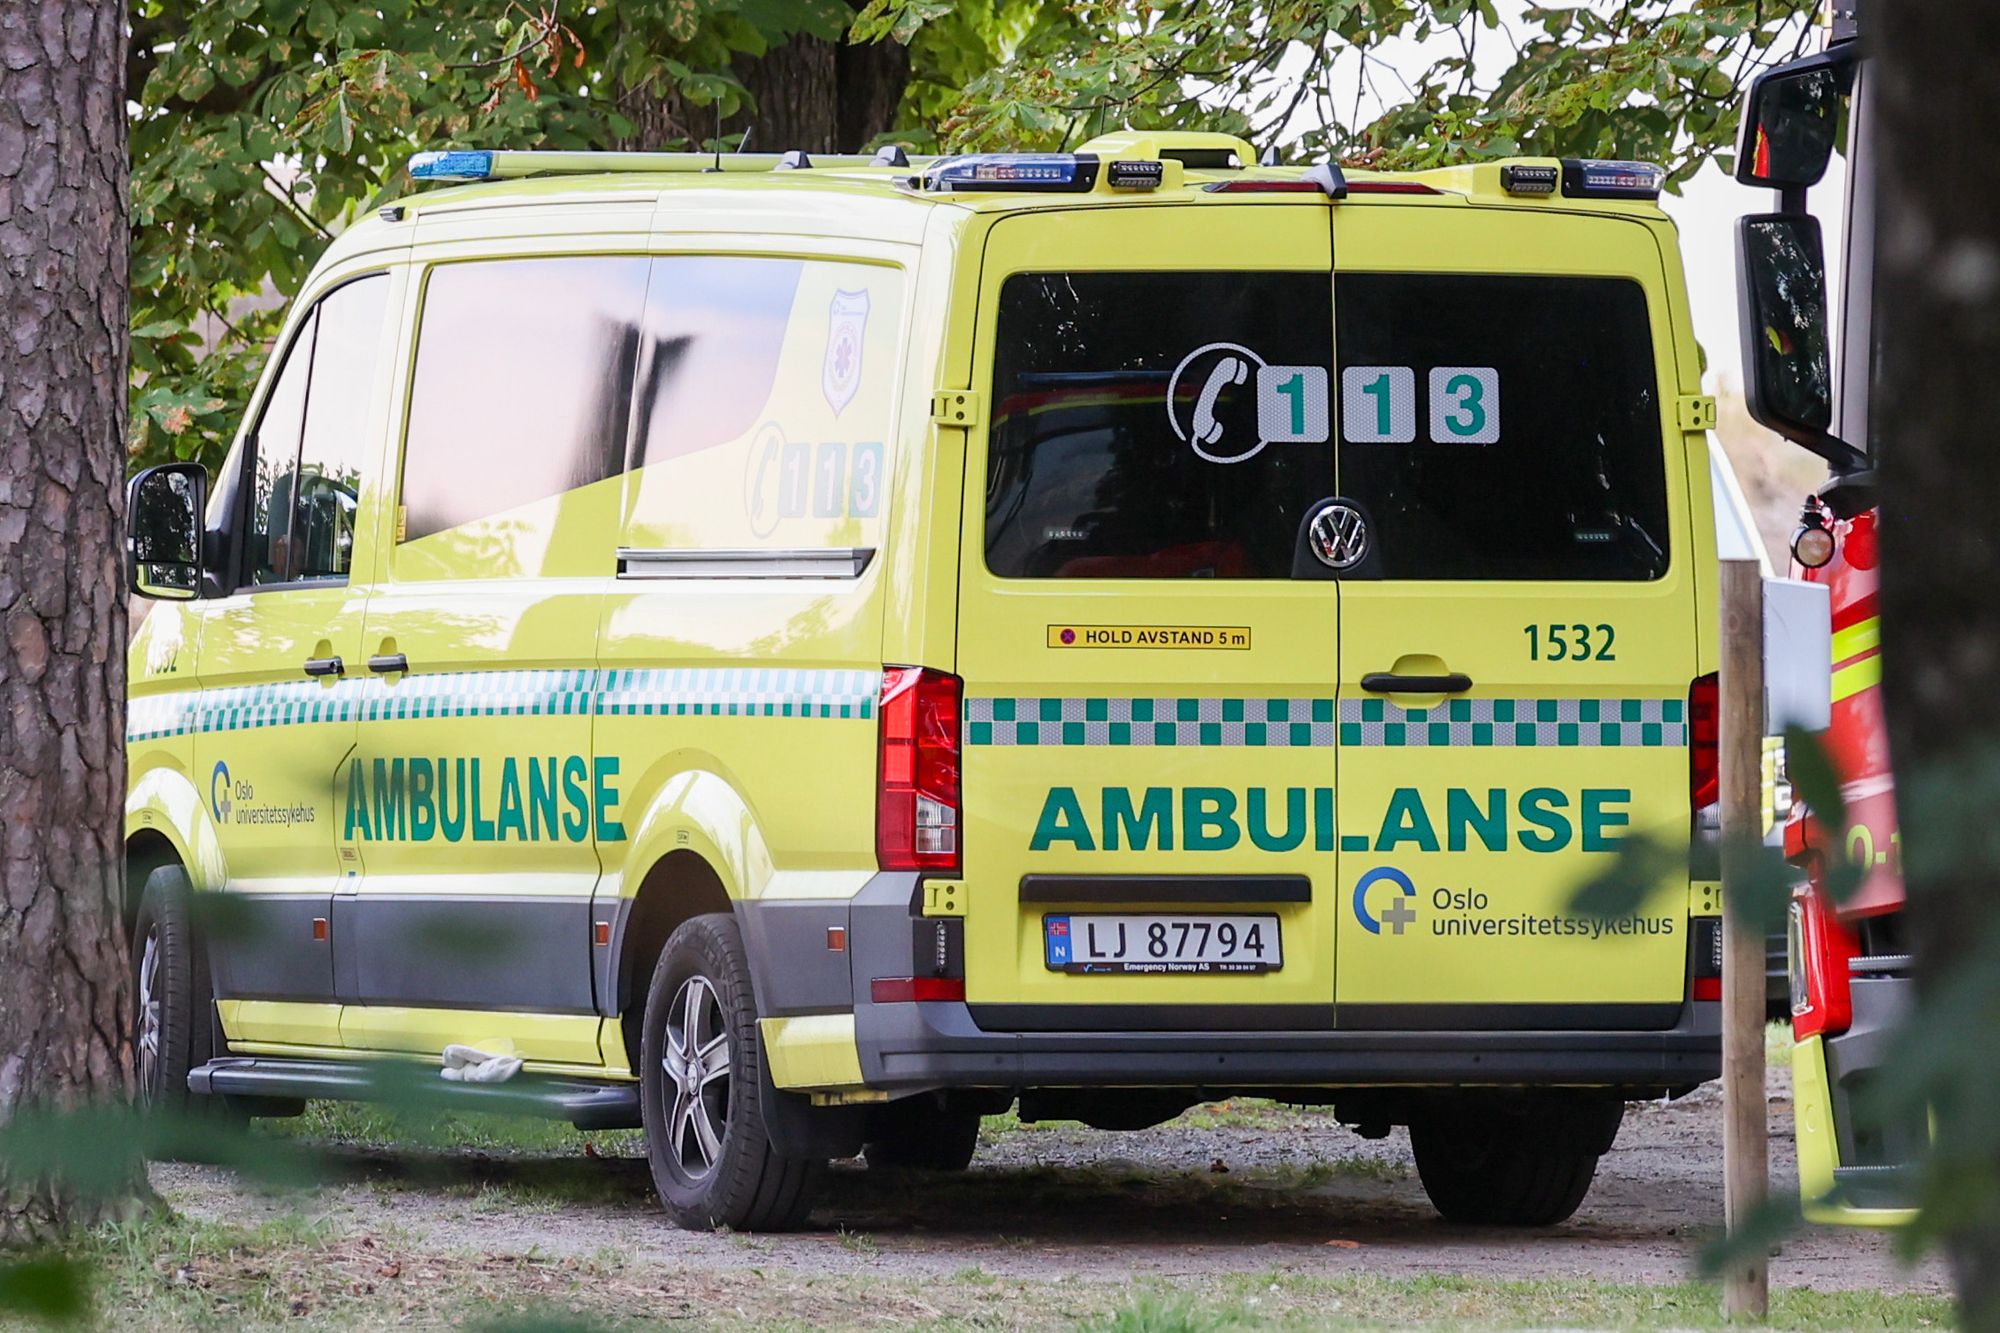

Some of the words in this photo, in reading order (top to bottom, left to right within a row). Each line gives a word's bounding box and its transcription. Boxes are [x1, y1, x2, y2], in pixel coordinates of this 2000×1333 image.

[1276, 373, 1487, 436] 113
[787, 448, 877, 512] 113
[1086, 630, 1132, 644] HOLD
[1137, 630, 1214, 646] AVSTAND
[1218, 631, 1227, 645] 5
[1232, 634, 1246, 645] m
[1523, 623, 1616, 662] 1532
[235, 779, 254, 801] Oslo
[344, 755, 627, 843] AMBULANSE
[236, 801, 316, 828] universitetssykehus
[1028, 786, 1632, 853] AMBULANSE
[1432, 887, 1489, 911] Oslo
[1432, 913, 1674, 940] universitetssykehus
[1054, 946, 1066, 958] N
[1088, 923, 1128, 959] LJ
[1147, 922, 1266, 959] 87794
[1123, 962, 1167, 973] Emergency
[1168, 962, 1198, 973] Norway
[1198, 962, 1210, 972] AS
